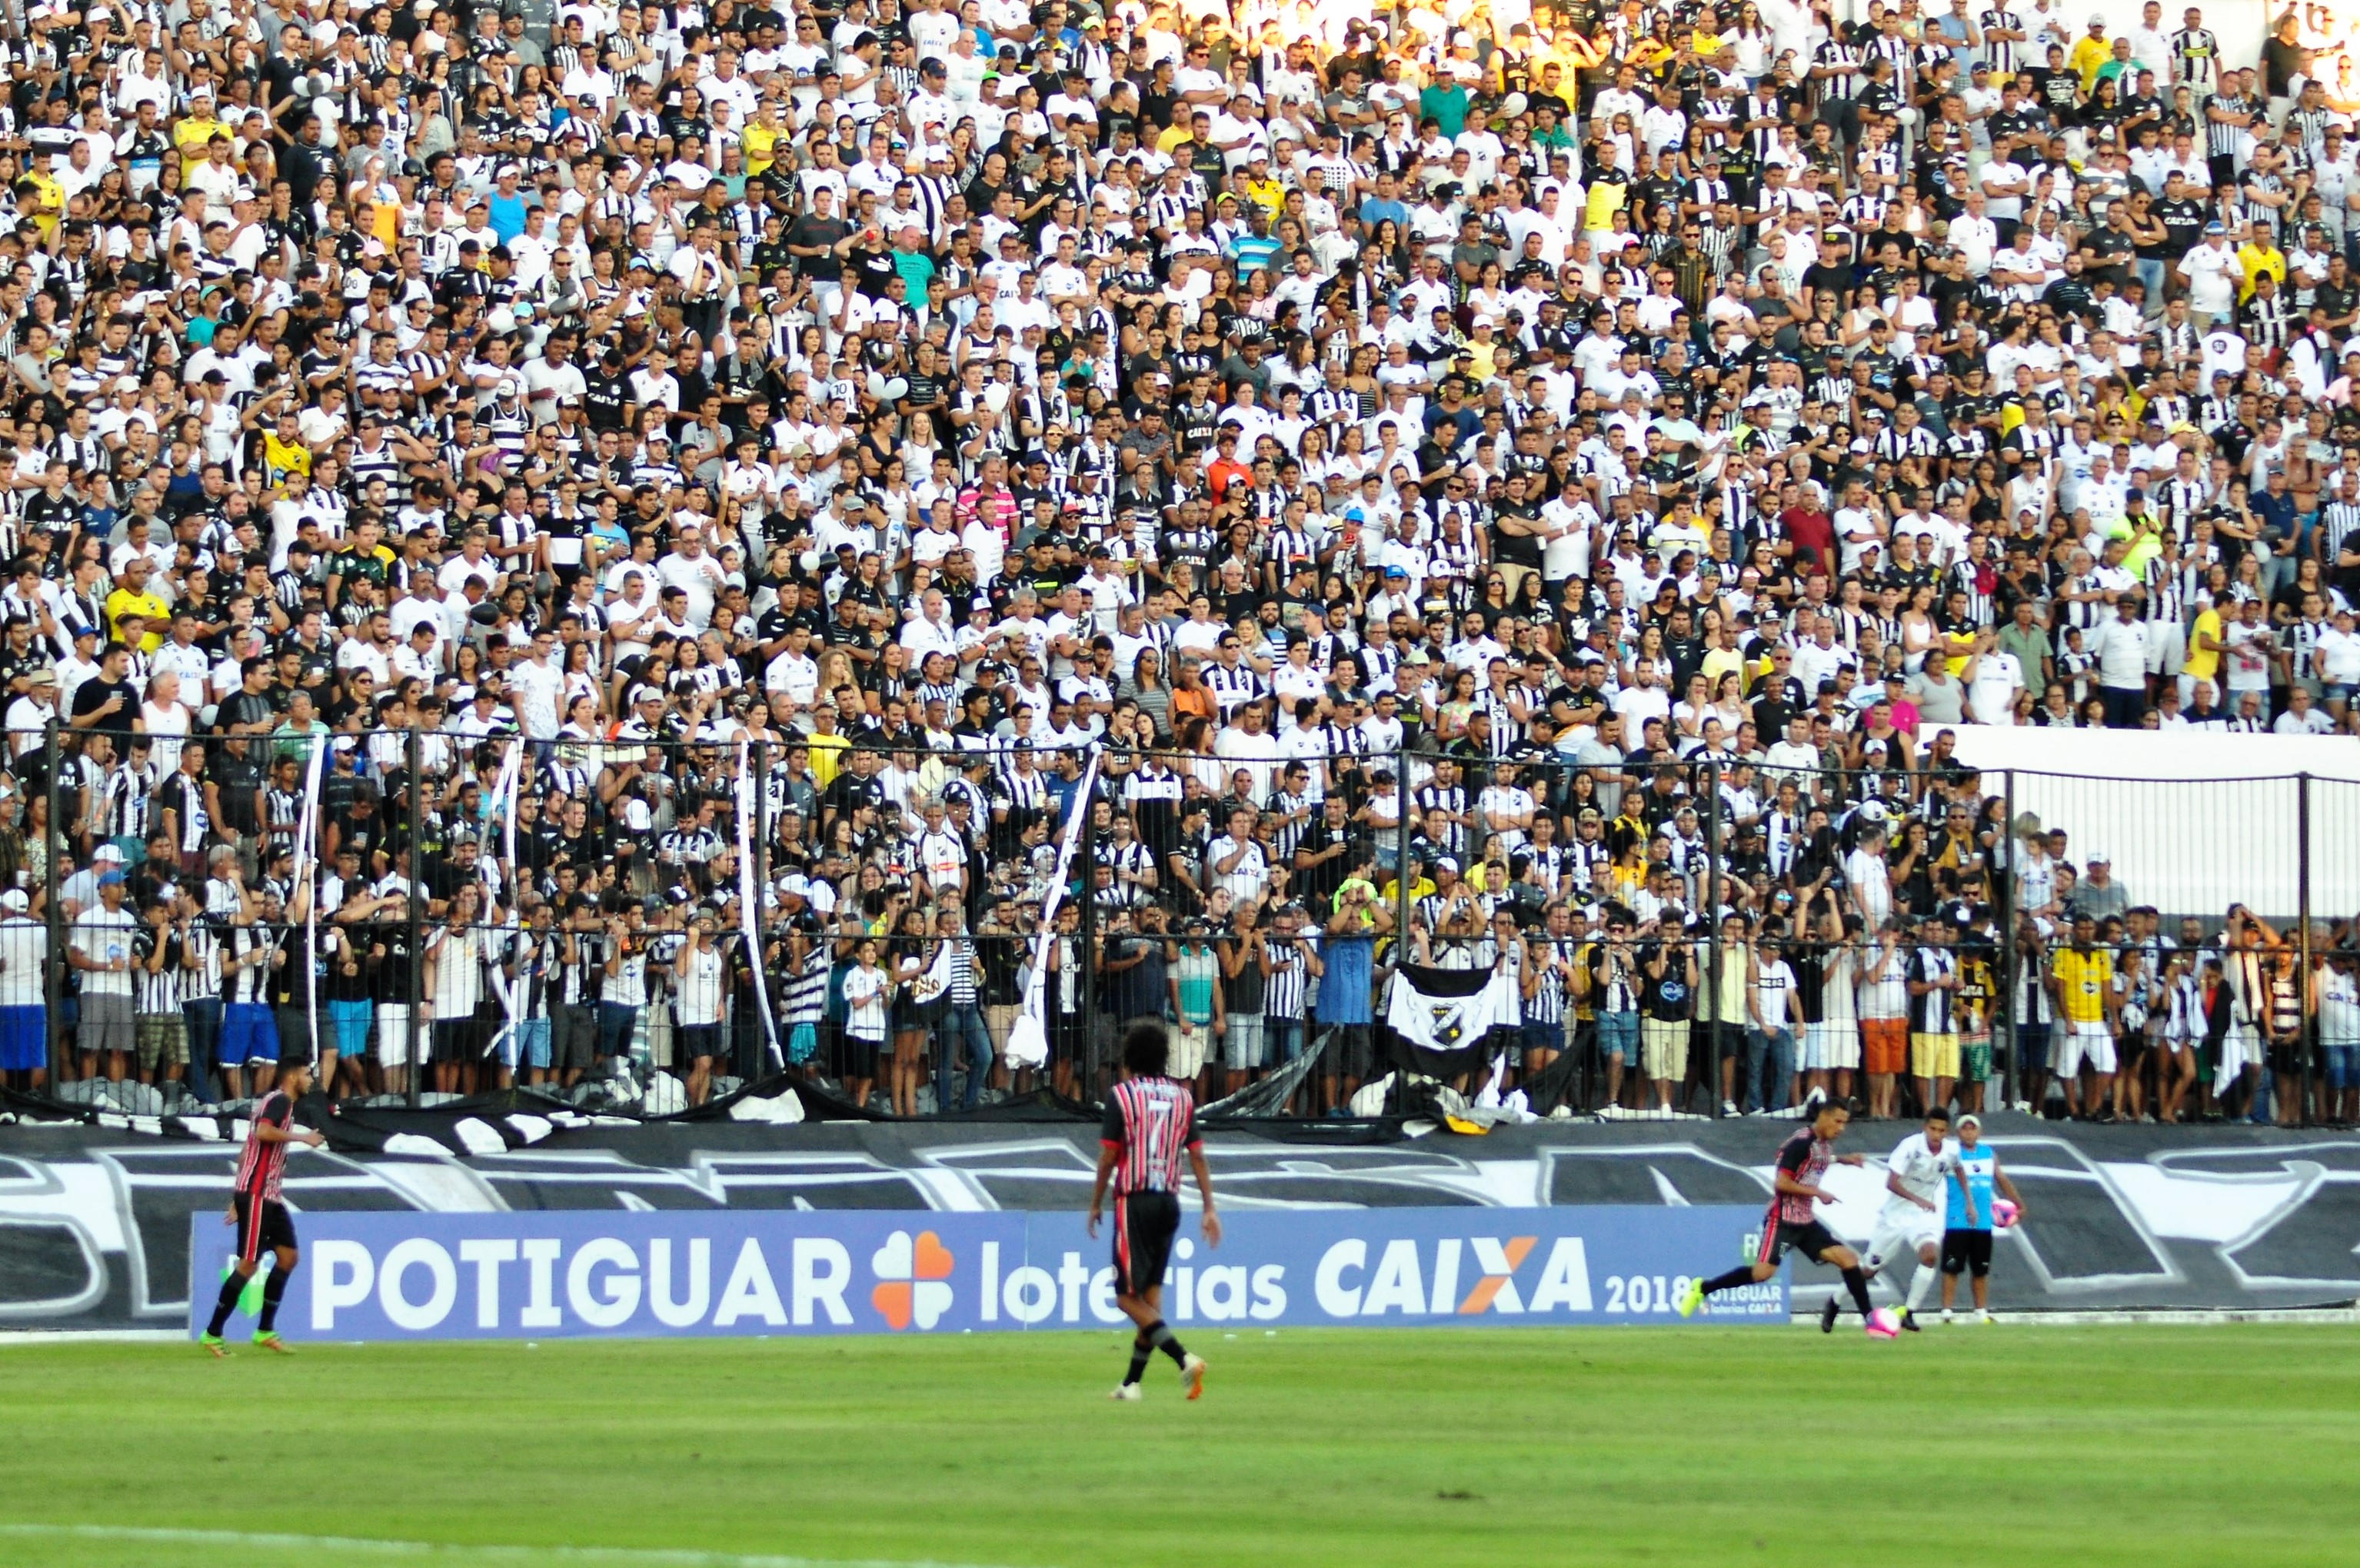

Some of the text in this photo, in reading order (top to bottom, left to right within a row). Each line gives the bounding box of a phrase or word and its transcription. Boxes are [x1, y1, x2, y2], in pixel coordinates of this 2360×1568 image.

[1187, 427, 1212, 438] CAIXA
[1147, 1100, 1172, 1154] 7
[311, 1237, 854, 1330] POTIGUAR
[980, 1237, 1287, 1322] loteias
[1313, 1237, 1594, 1317] CAIXA
[1604, 1274, 1693, 1313] 2018
[1708, 1285, 1781, 1301] OTIGUAR
